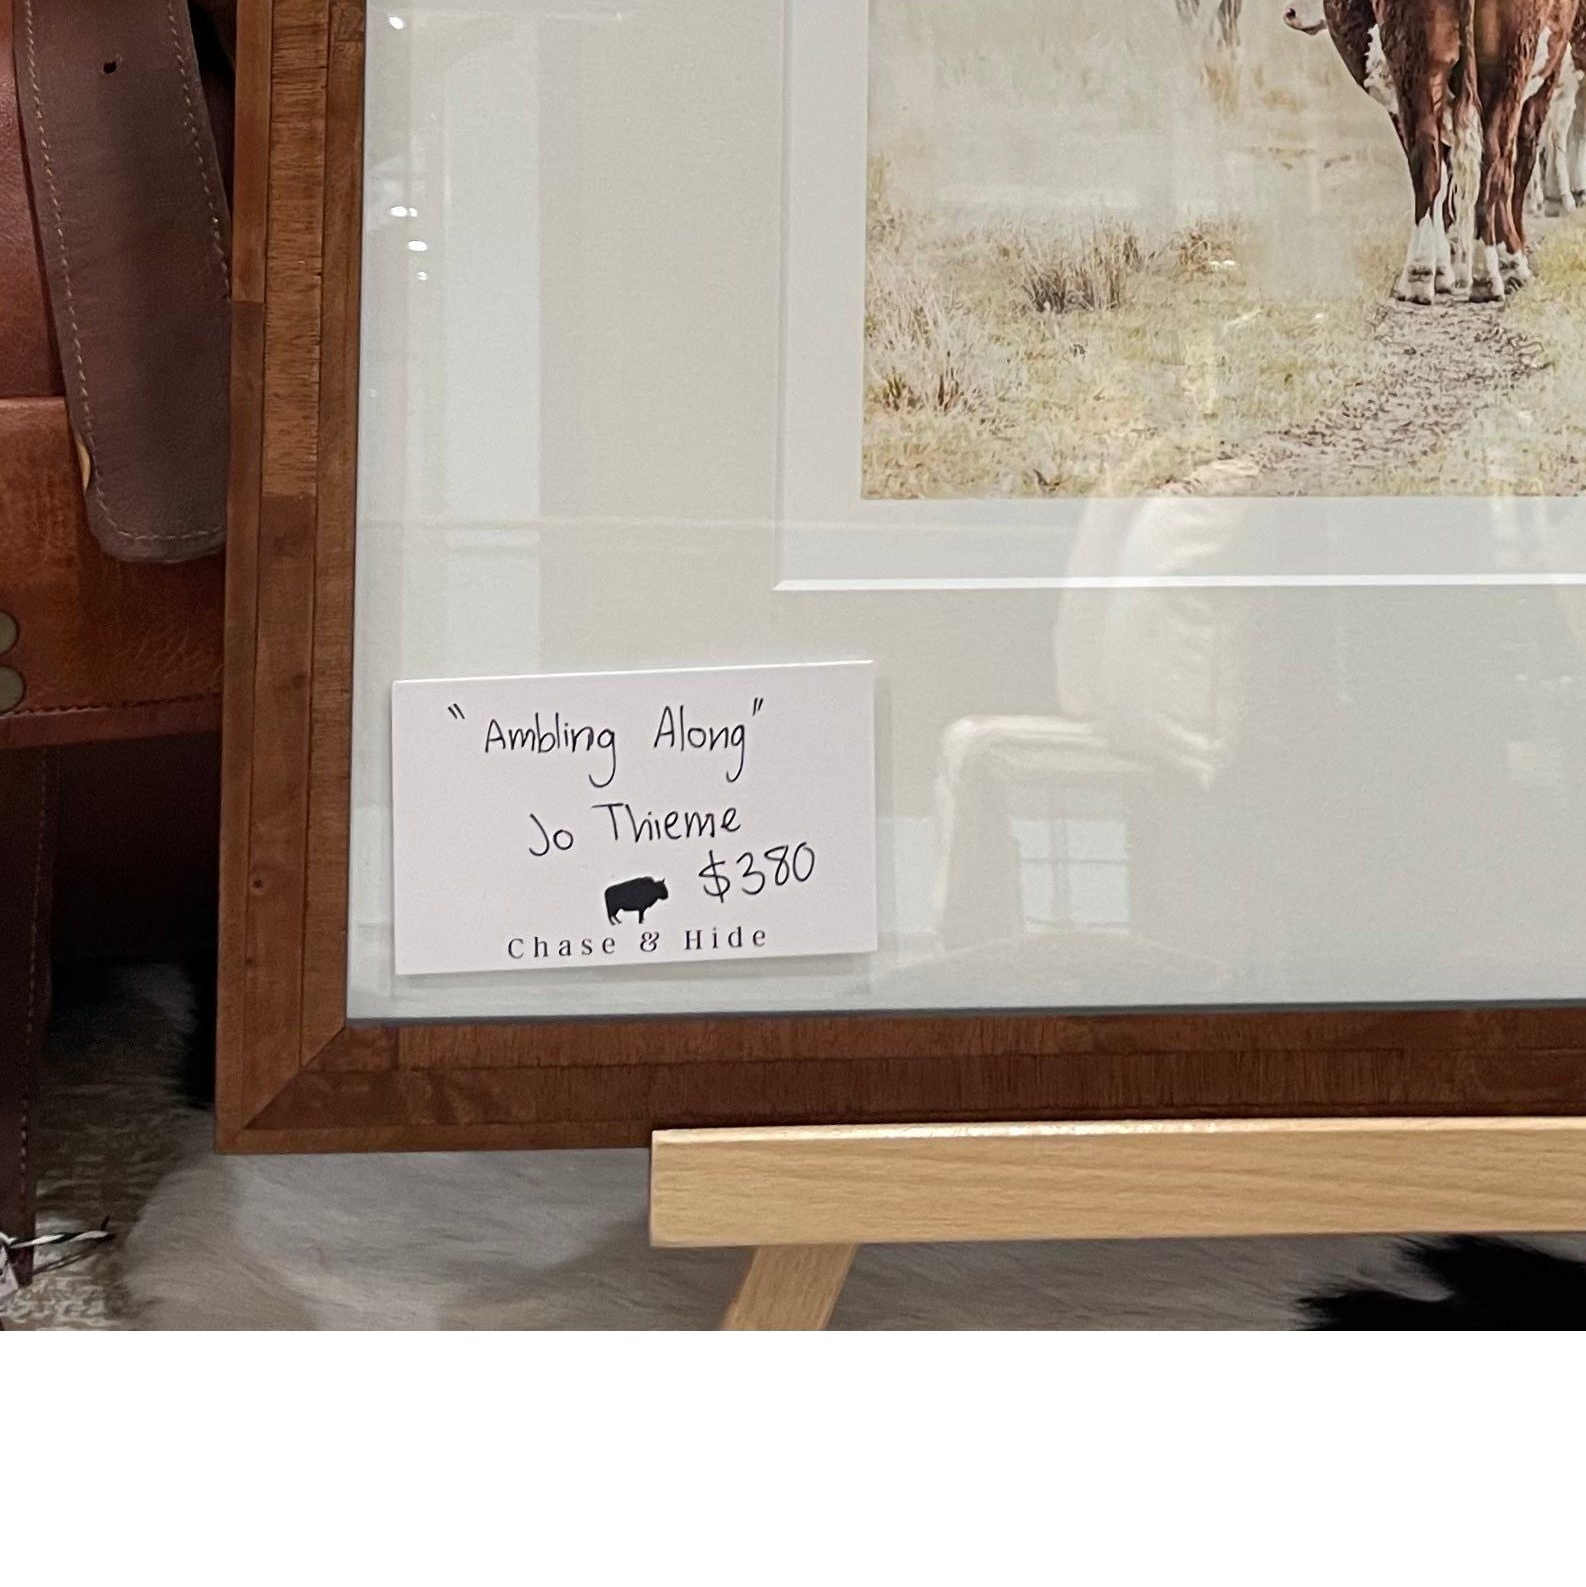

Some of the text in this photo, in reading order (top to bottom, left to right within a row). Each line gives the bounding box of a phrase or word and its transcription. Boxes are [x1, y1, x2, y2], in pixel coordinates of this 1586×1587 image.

[528, 802, 742, 857] Jo Thieme
[697, 841, 816, 903] $380
[507, 926, 768, 960] Chase & Hide
